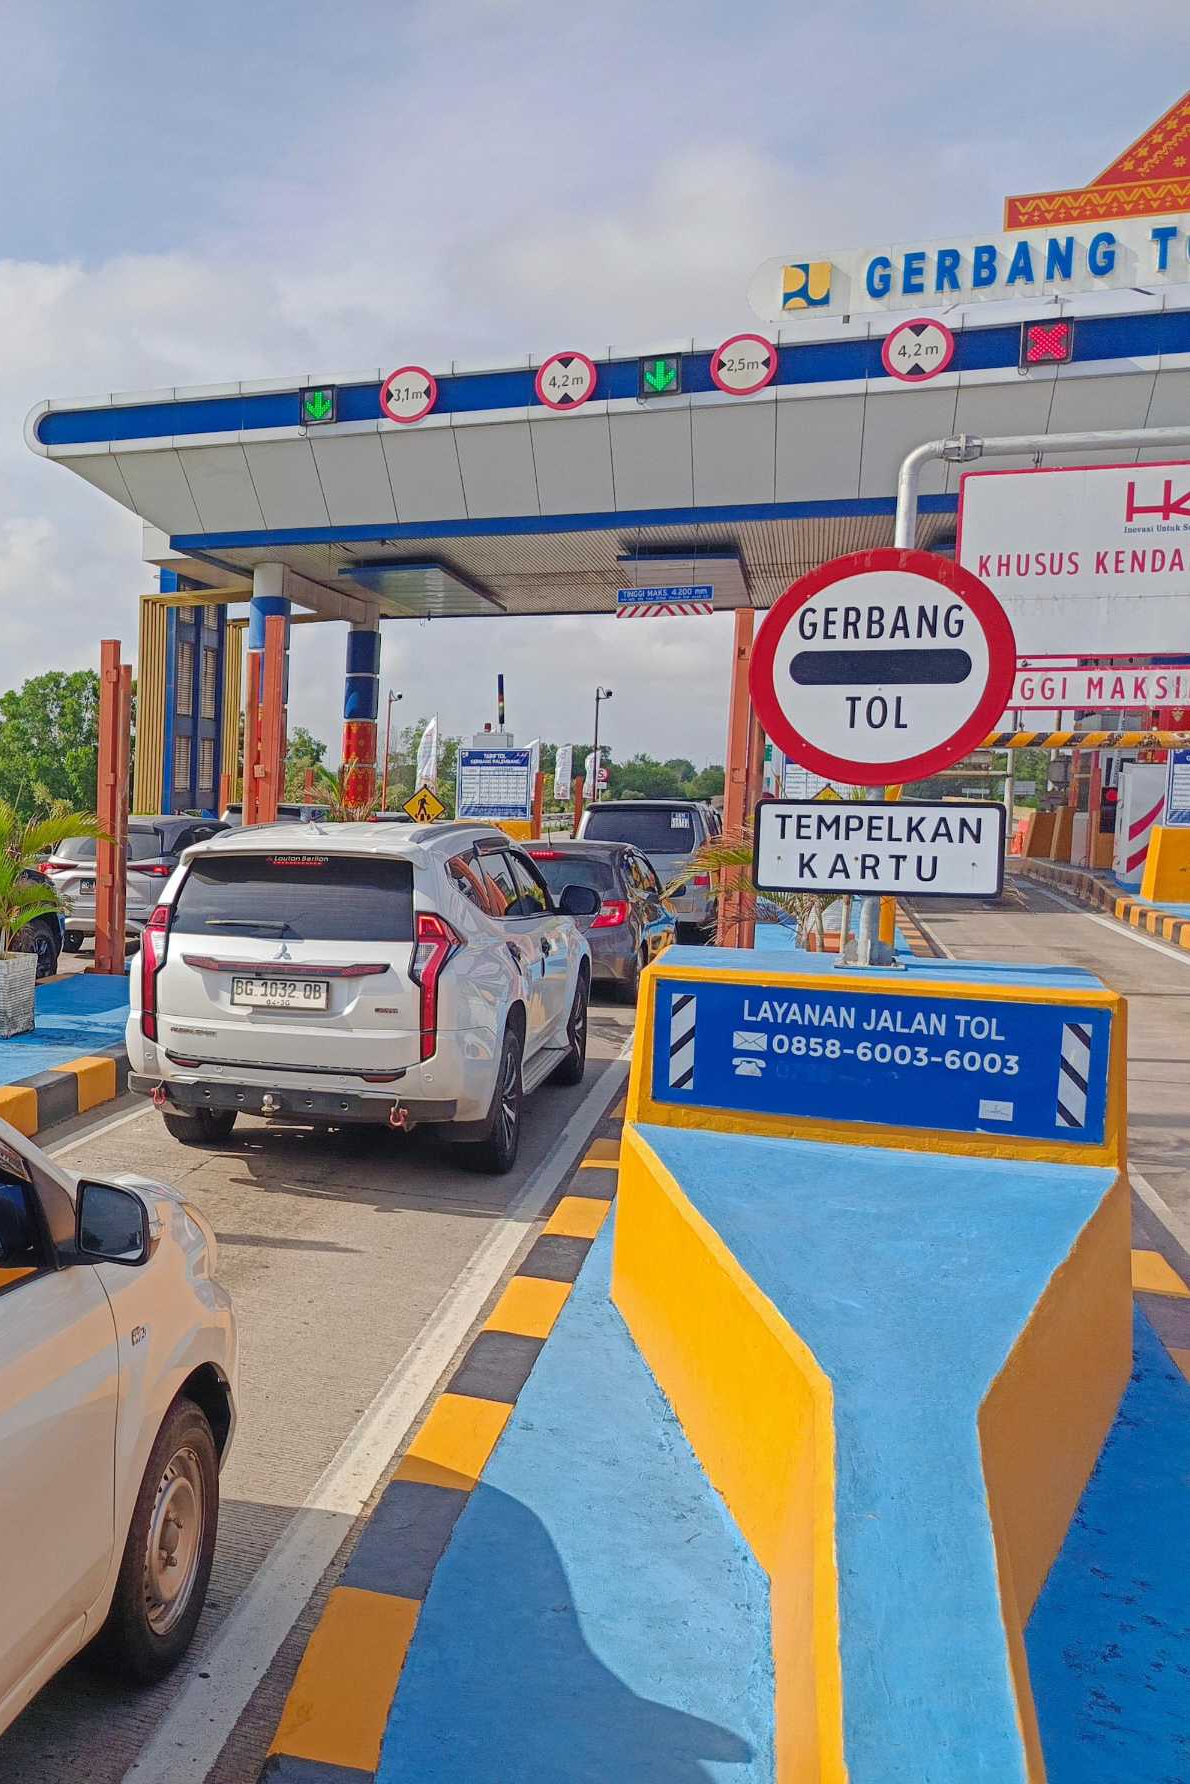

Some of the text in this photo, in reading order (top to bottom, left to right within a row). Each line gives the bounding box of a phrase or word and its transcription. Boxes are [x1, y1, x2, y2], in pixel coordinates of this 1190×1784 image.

[865, 226, 1190, 298] GERBANG T
[1156, 523, 1180, 533] Untuk
[978, 548, 1190, 577] KHUSUS KENDA
[798, 604, 965, 641] GERBANG
[1086, 675, 1190, 700] MAKSI
[845, 695, 908, 729] TOL
[774, 813, 983, 844] TEMPELKAN
[798, 852, 939, 882] KARTU
[235, 980, 254, 997] BG
[260, 981, 297, 998] 1032
[742, 999, 1006, 1041] LAYANAN JALAN TOL
[771, 1033, 1020, 1076] 0858-6003-6003
